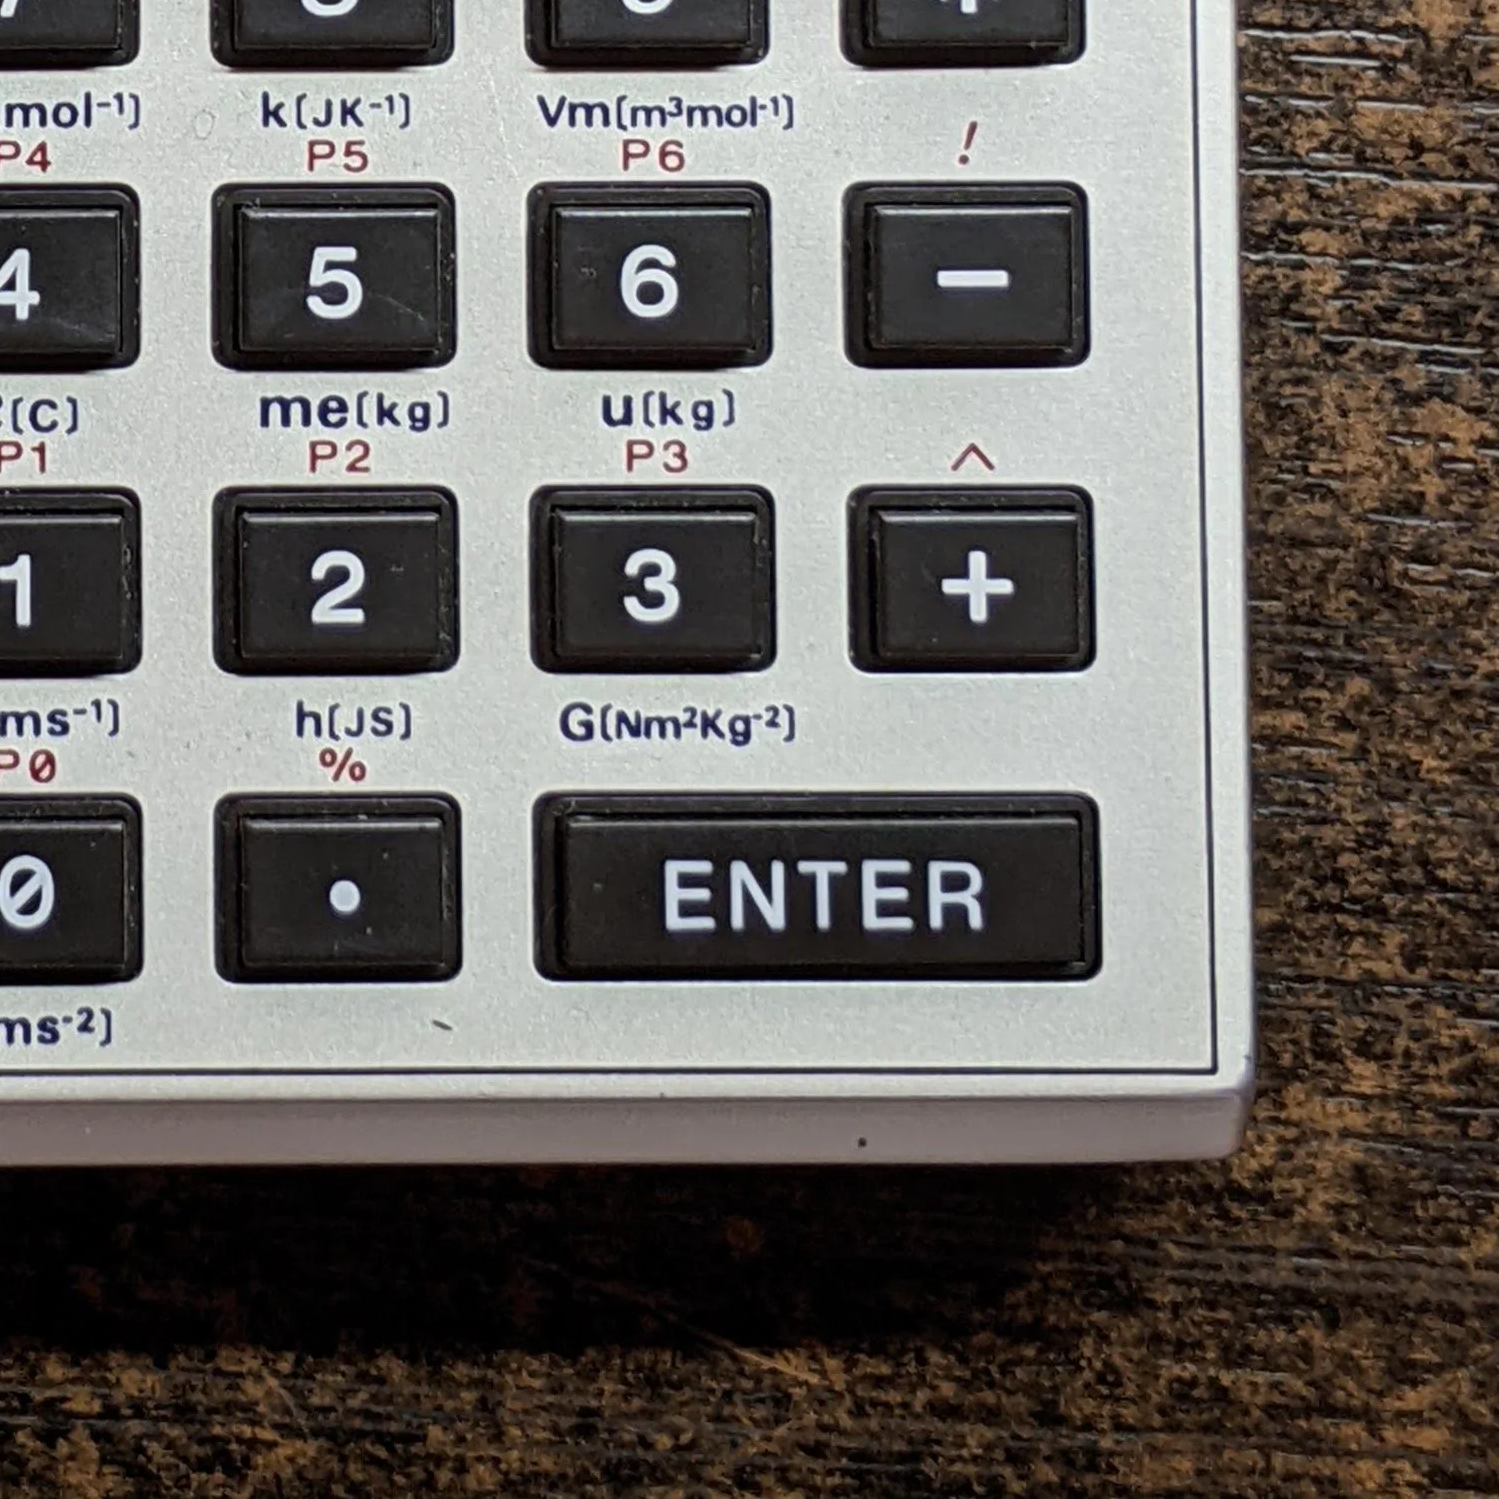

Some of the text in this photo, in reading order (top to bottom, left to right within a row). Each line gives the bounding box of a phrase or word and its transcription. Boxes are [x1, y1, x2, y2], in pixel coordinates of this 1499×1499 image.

[306, 139, 369, 173] P5
[621, 139, 686, 172] P6
[958, 121, 978, 165] !
[306, 246, 363, 319] 5
[620, 244, 678, 318] 6
[309, 440, 370, 473] P2
[626, 439, 689, 473] P3
[311, 550, 365, 625] 2
[623, 549, 680, 623] 3
[319, 747, 367, 781] %
[664, 860, 985, 932] ENTER
